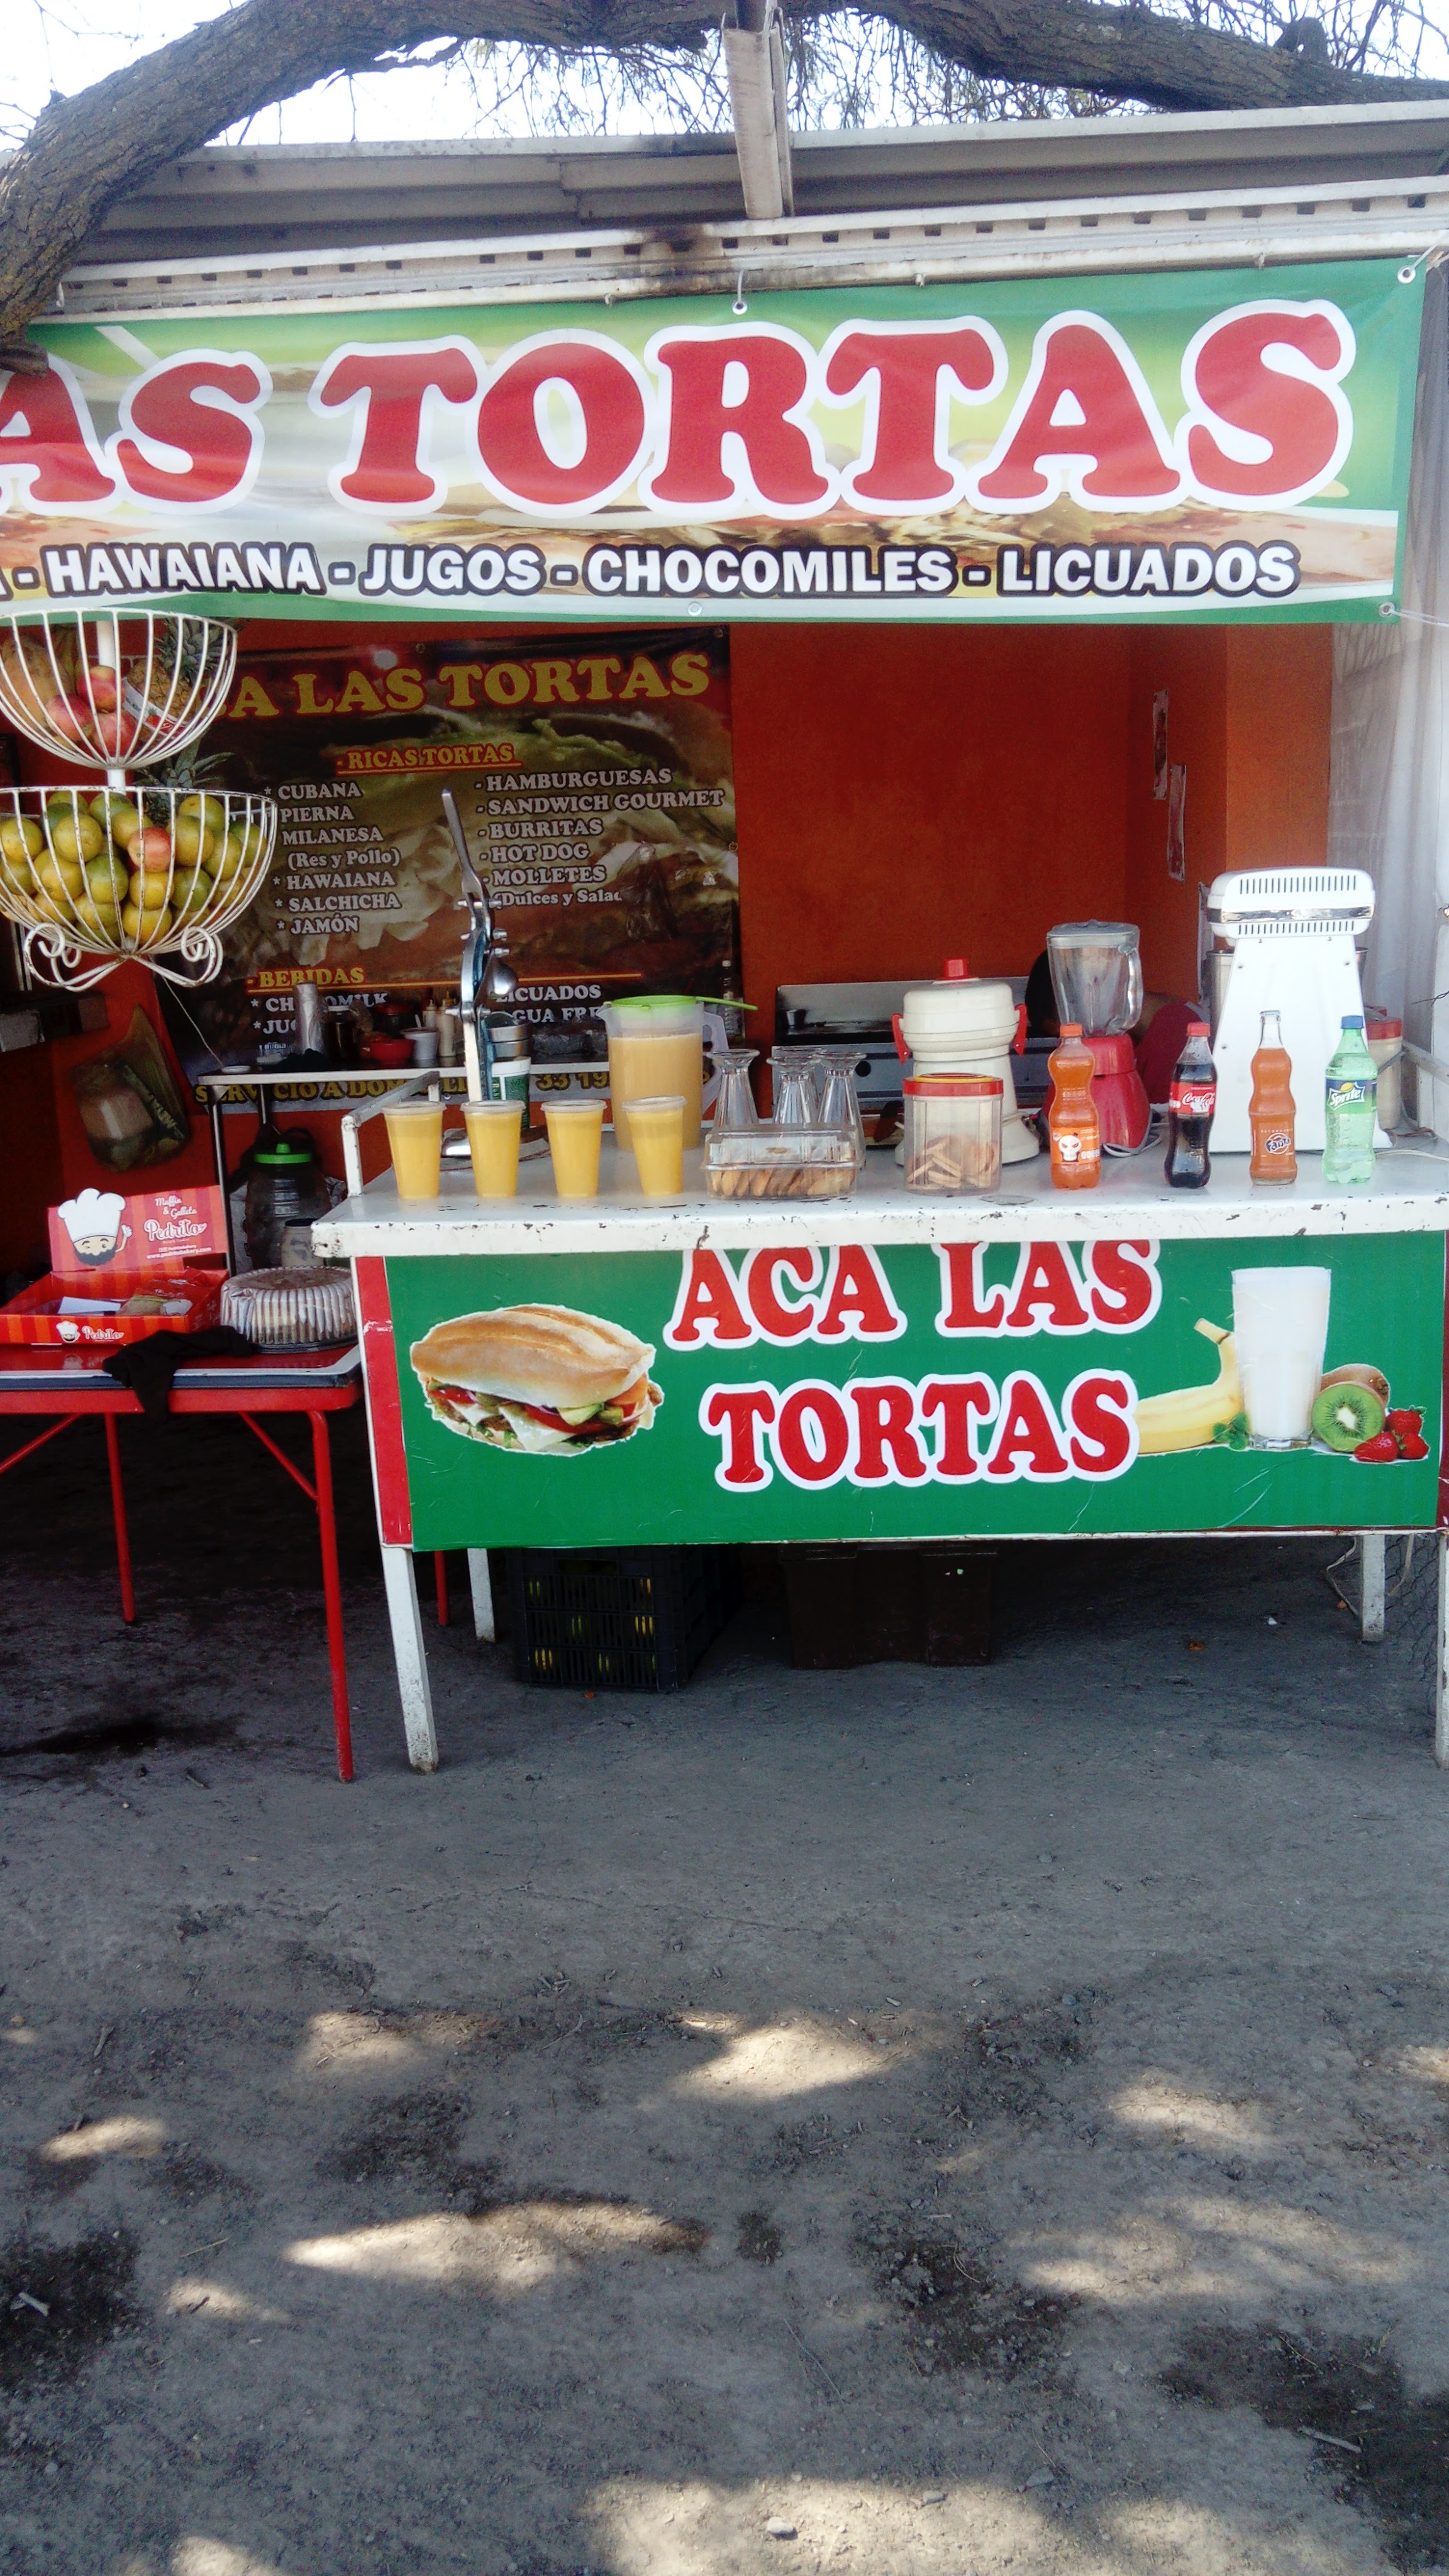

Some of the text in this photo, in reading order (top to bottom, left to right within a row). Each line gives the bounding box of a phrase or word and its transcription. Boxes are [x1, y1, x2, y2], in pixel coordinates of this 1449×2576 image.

[319, 309, 1343, 507] TORTAS
[45, 546, 322, 593] HAWAIANA
[363, 548, 542, 592] JUGOS
[587, 548, 955, 593] CHOCOMILES
[1002, 545, 1297, 593] LICUADOS
[292, 667, 425, 714] LAS
[439, 653, 710, 708] TORTAS
[347, 743, 515, 770] RICAS TORTAS
[277, 781, 363, 801] CUBANA
[486, 768, 672, 792] HAMBURGUESAS
[280, 804, 355, 823] PIERNA
[488, 789, 724, 816] SANDWICH GOURMET
[282, 826, 384, 846] MILANESA
[489, 818, 603, 840] BURRITAS
[287, 852, 326, 871] (Res
[491, 843, 590, 863] HOT DOG
[286, 870, 397, 892] HAWAIANA
[492, 865, 607, 887] MOLLETES
[288, 892, 402, 913] SALCHICHA
[290, 913, 360, 935] JAMÓN
[1329, 1089, 1362, 1107] Sprite
[143, 1219, 208, 1241] Pedrito
[672, 1239, 1153, 1342] ACA LAS
[707, 1376, 1132, 1484] TORTAS
